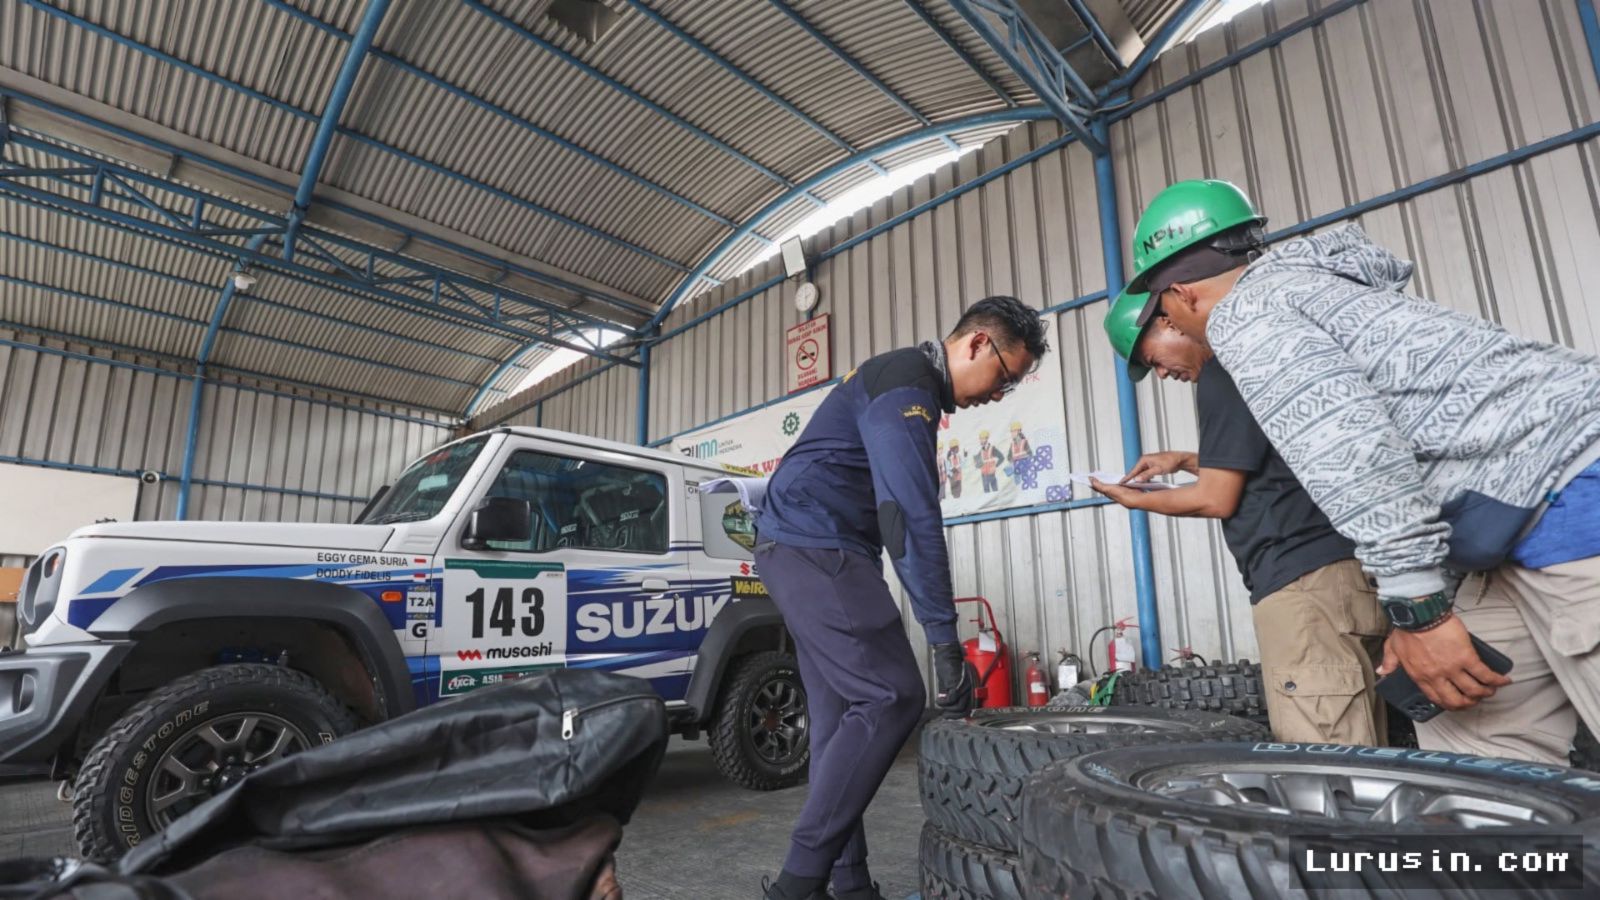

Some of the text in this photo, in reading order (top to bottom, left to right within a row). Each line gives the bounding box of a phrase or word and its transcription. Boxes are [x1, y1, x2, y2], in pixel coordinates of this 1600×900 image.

[317, 552, 408, 567] EGGY GEMA SURIA
[316, 568, 391, 580] DODDY FIDELIS
[409, 597, 434, 607] T2A
[465, 587, 545, 638] 143
[575, 594, 741, 643] SUZUK
[412, 622, 427, 638] G
[486, 642, 552, 660] musashi
[482, 674, 502, 684] ASIA
[1252, 742, 1568, 777] DUELER
